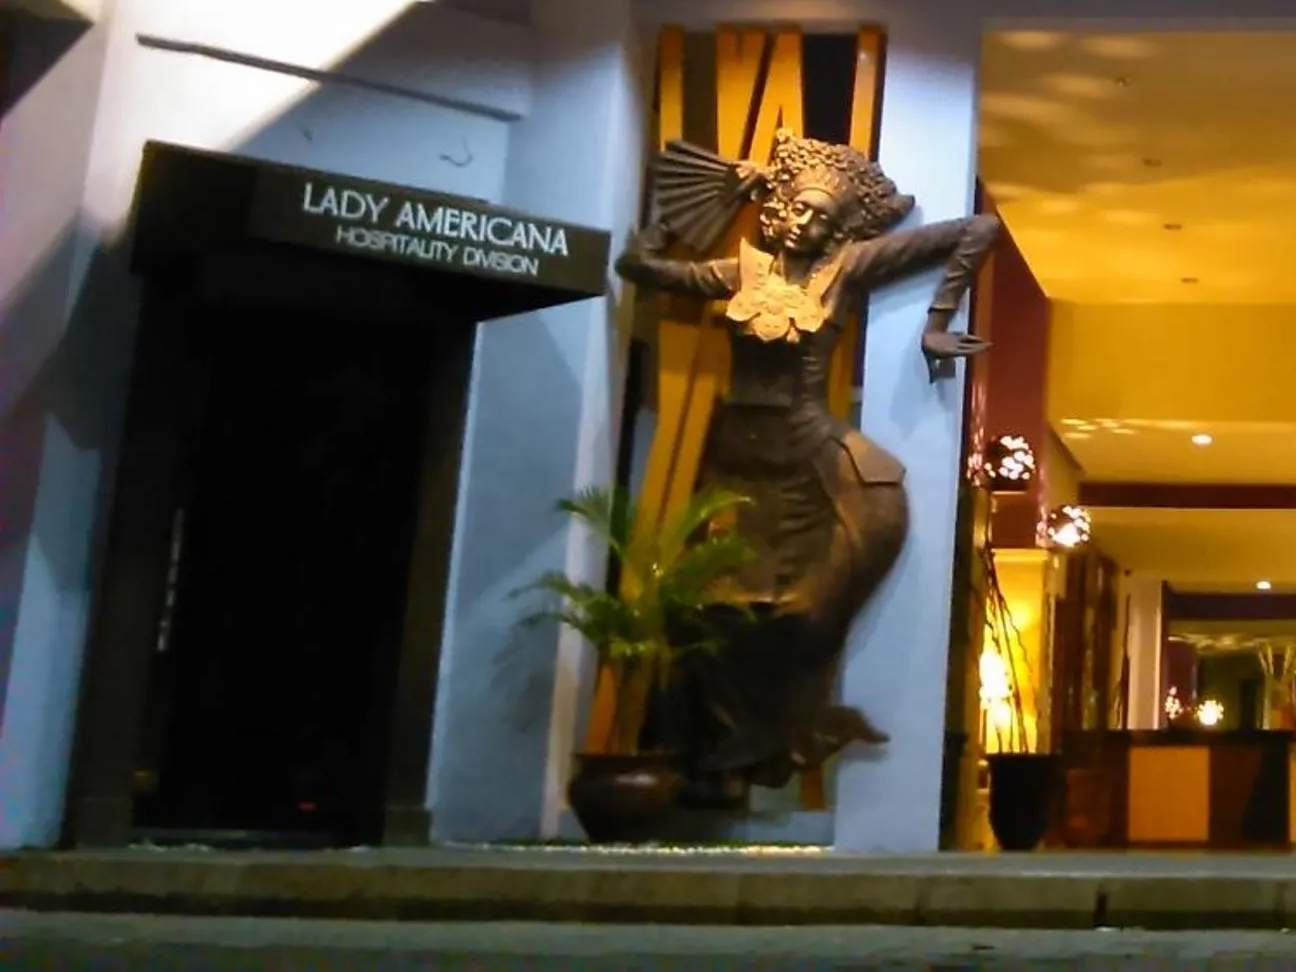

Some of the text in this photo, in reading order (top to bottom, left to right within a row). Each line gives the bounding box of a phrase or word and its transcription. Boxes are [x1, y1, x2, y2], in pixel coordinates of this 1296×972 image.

[303, 182, 569, 257] LADY AMERICANA
[335, 224, 539, 276] HOSPITALITY DIVISION
